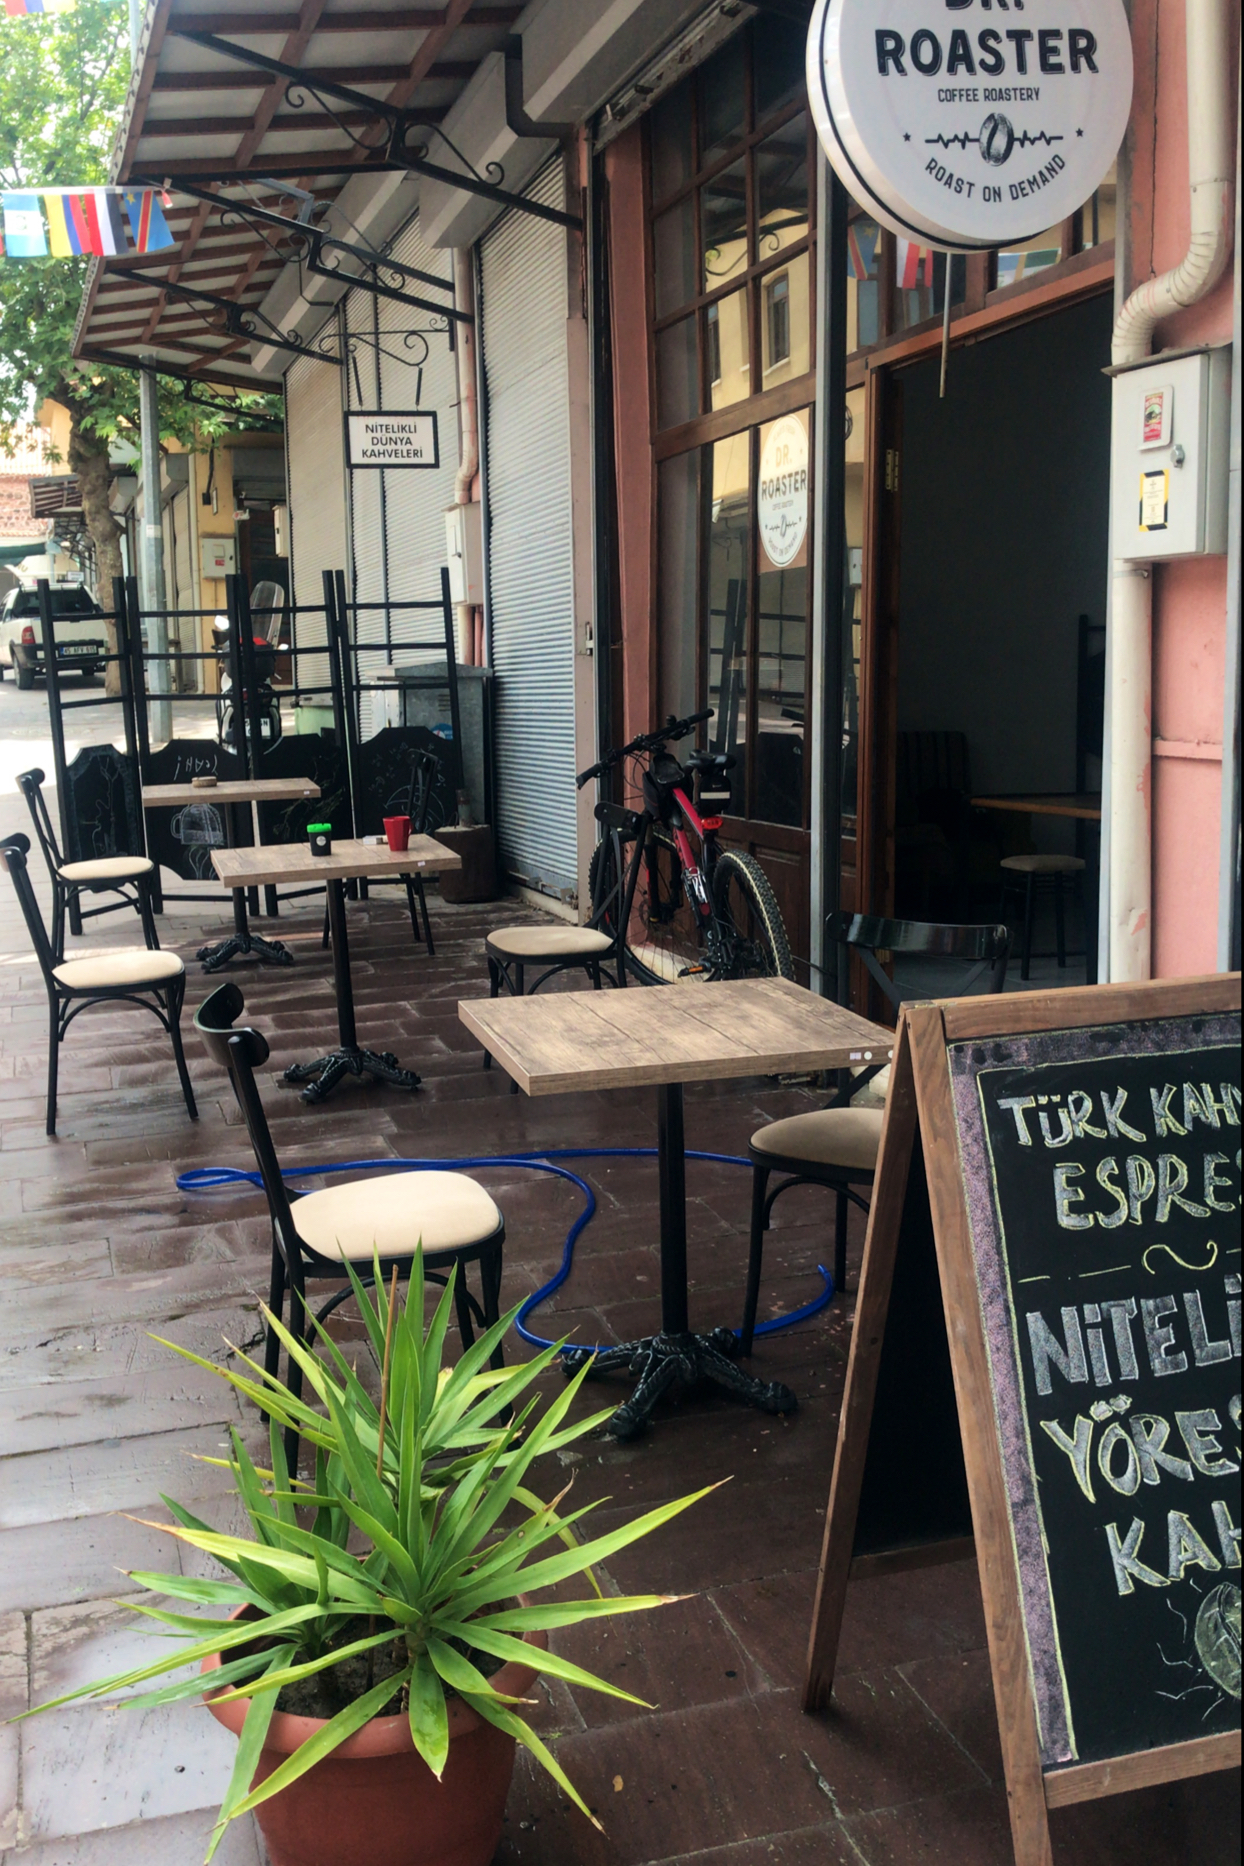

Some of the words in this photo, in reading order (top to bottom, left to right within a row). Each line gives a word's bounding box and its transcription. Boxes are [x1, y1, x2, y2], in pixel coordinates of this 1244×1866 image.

[875, 28, 1099, 76] ROASTER
[937, 88, 979, 103] COFFEE
[983, 87, 1041, 102] ROASTERY
[925, 157, 976, 198] ROAST
[982, 186, 1002, 202] ON
[1008, 153, 1066, 201] DEMAND
[365, 421, 417, 434] NİTELİKLİ
[371, 434, 413, 446] DÜNYA
[362, 446, 423, 459] KAHVELERİ
[761, 468, 807, 501] ROASTER
[997, 1086, 1147, 1148] TÜRK
[1149, 1082, 1242, 1137] KAH
[1053, 1148, 1242, 1230] ESPRE
[1040, 1393, 1242, 1504] YÖRE
